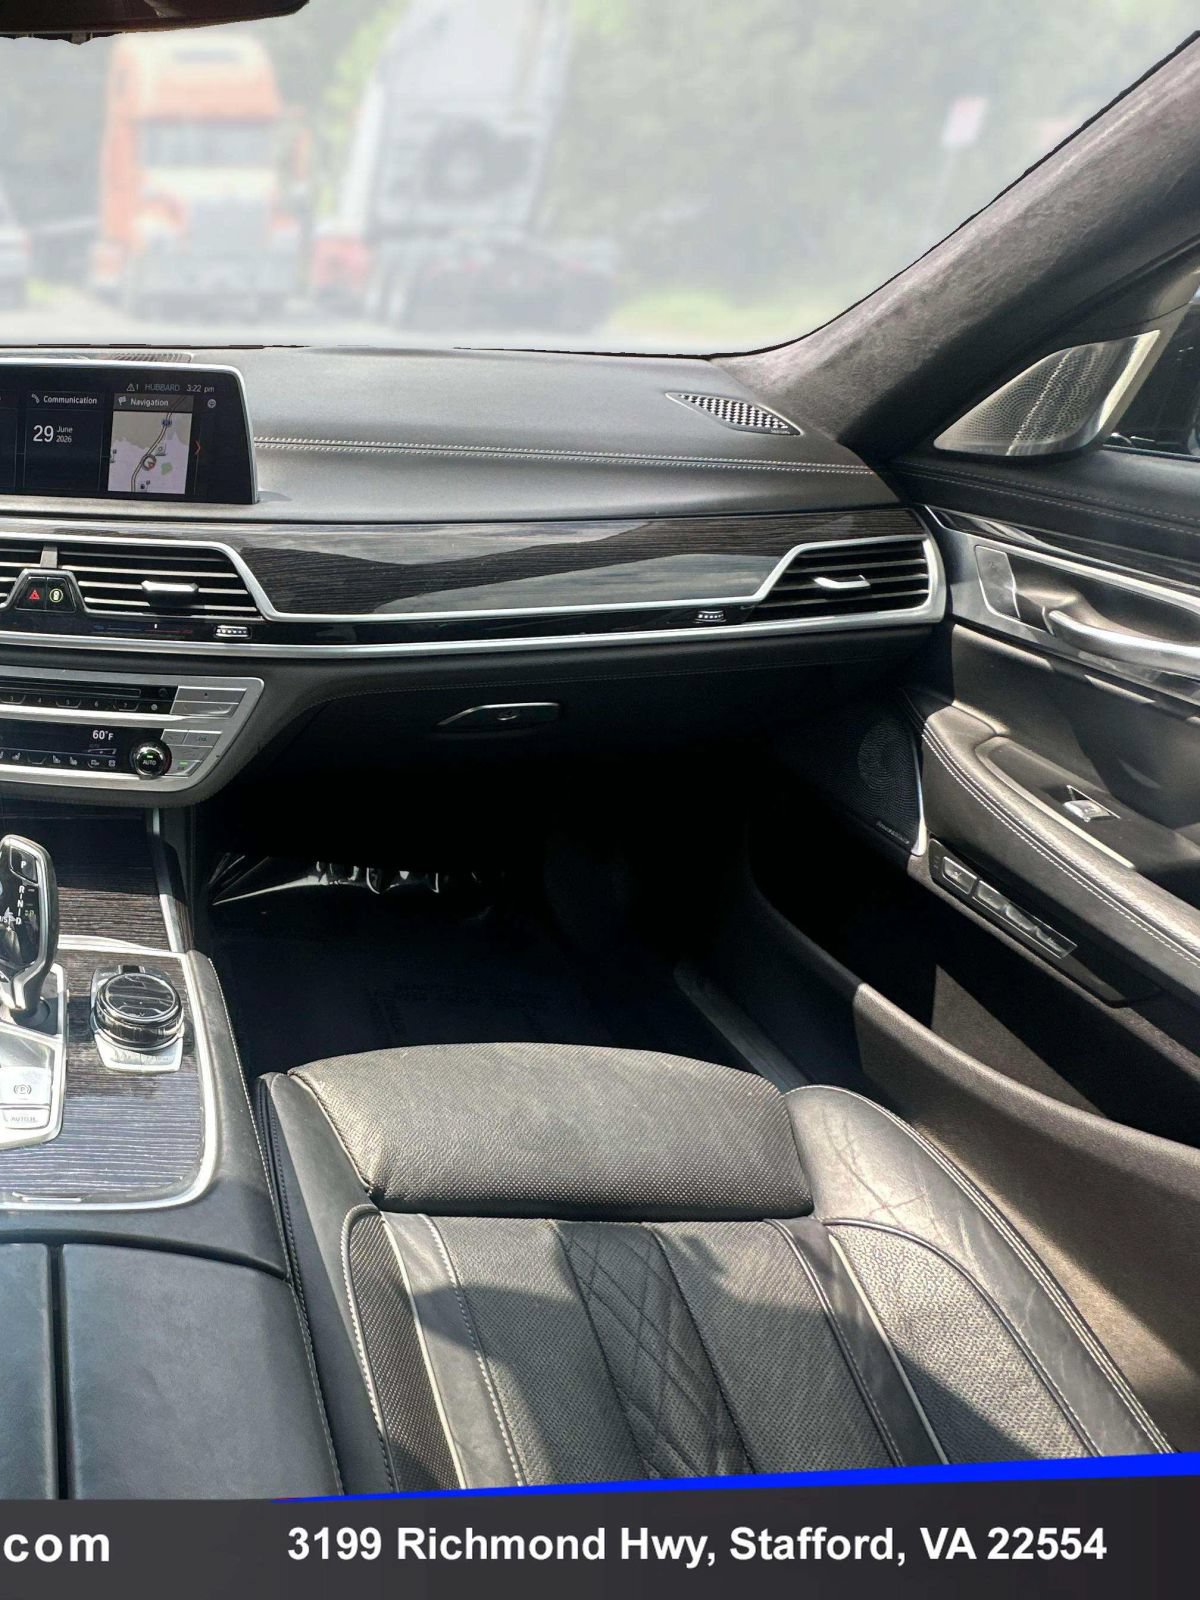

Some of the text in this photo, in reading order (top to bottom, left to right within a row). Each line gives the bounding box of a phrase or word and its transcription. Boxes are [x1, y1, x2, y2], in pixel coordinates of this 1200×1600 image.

[186, 384, 201, 392] 3:22
[43, 395, 98, 405] Communication
[130, 398, 169, 407] Navigation
[33, 425, 54, 443] 29
[56, 435, 73, 443] 2026
[92, 729, 114, 740] 60°F
[20, 860, 27, 869] P
[19, 885, 25, 894] R
[17, 900, 24, 908] N
[15, 917, 22, 925] D
